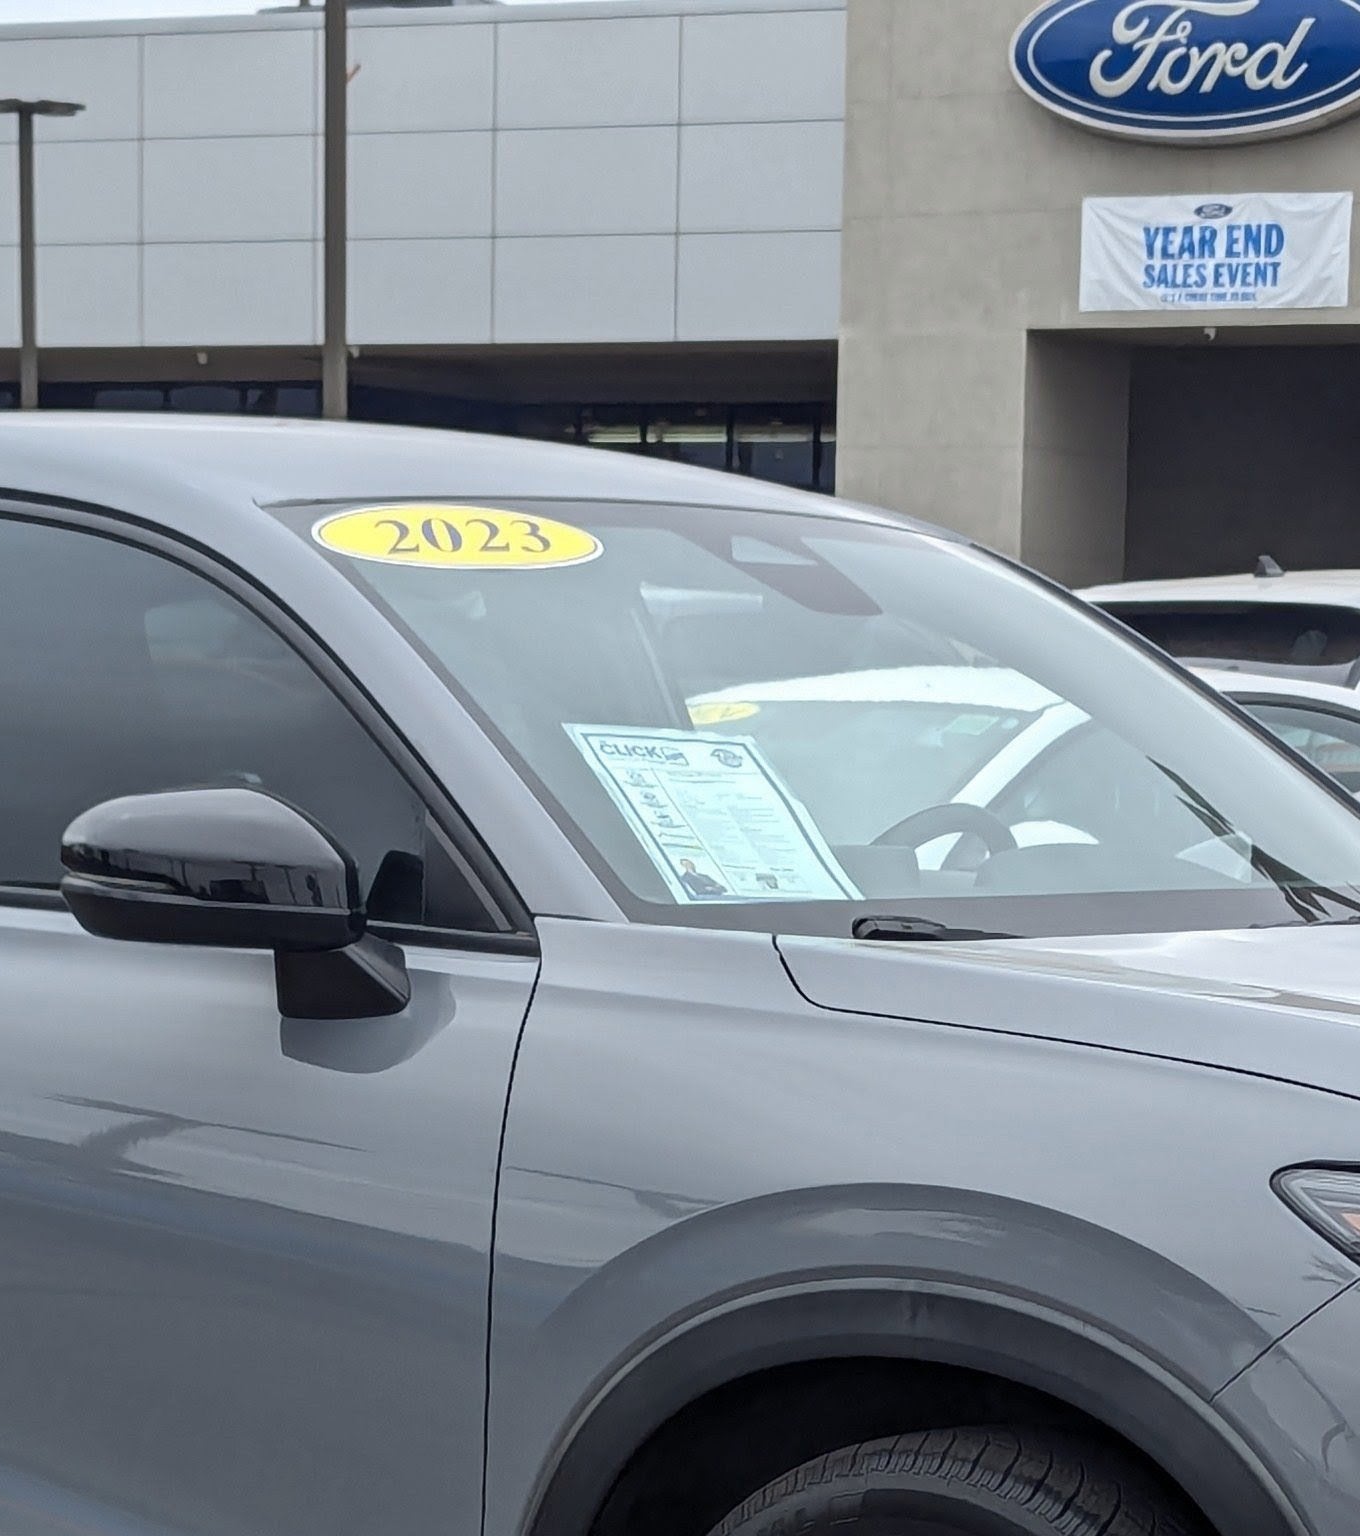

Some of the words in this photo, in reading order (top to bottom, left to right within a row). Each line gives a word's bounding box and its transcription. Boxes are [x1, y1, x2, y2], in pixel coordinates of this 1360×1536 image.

[1090, 0, 1316, 98] Ford
[1142, 225, 1218, 261] YEAR
[1225, 223, 1285, 259] END
[1142, 262, 1208, 289] SALES
[1212, 261, 1282, 288] EVENT
[373, 517, 552, 555] 2023
[599, 742, 663, 759] CLICK
